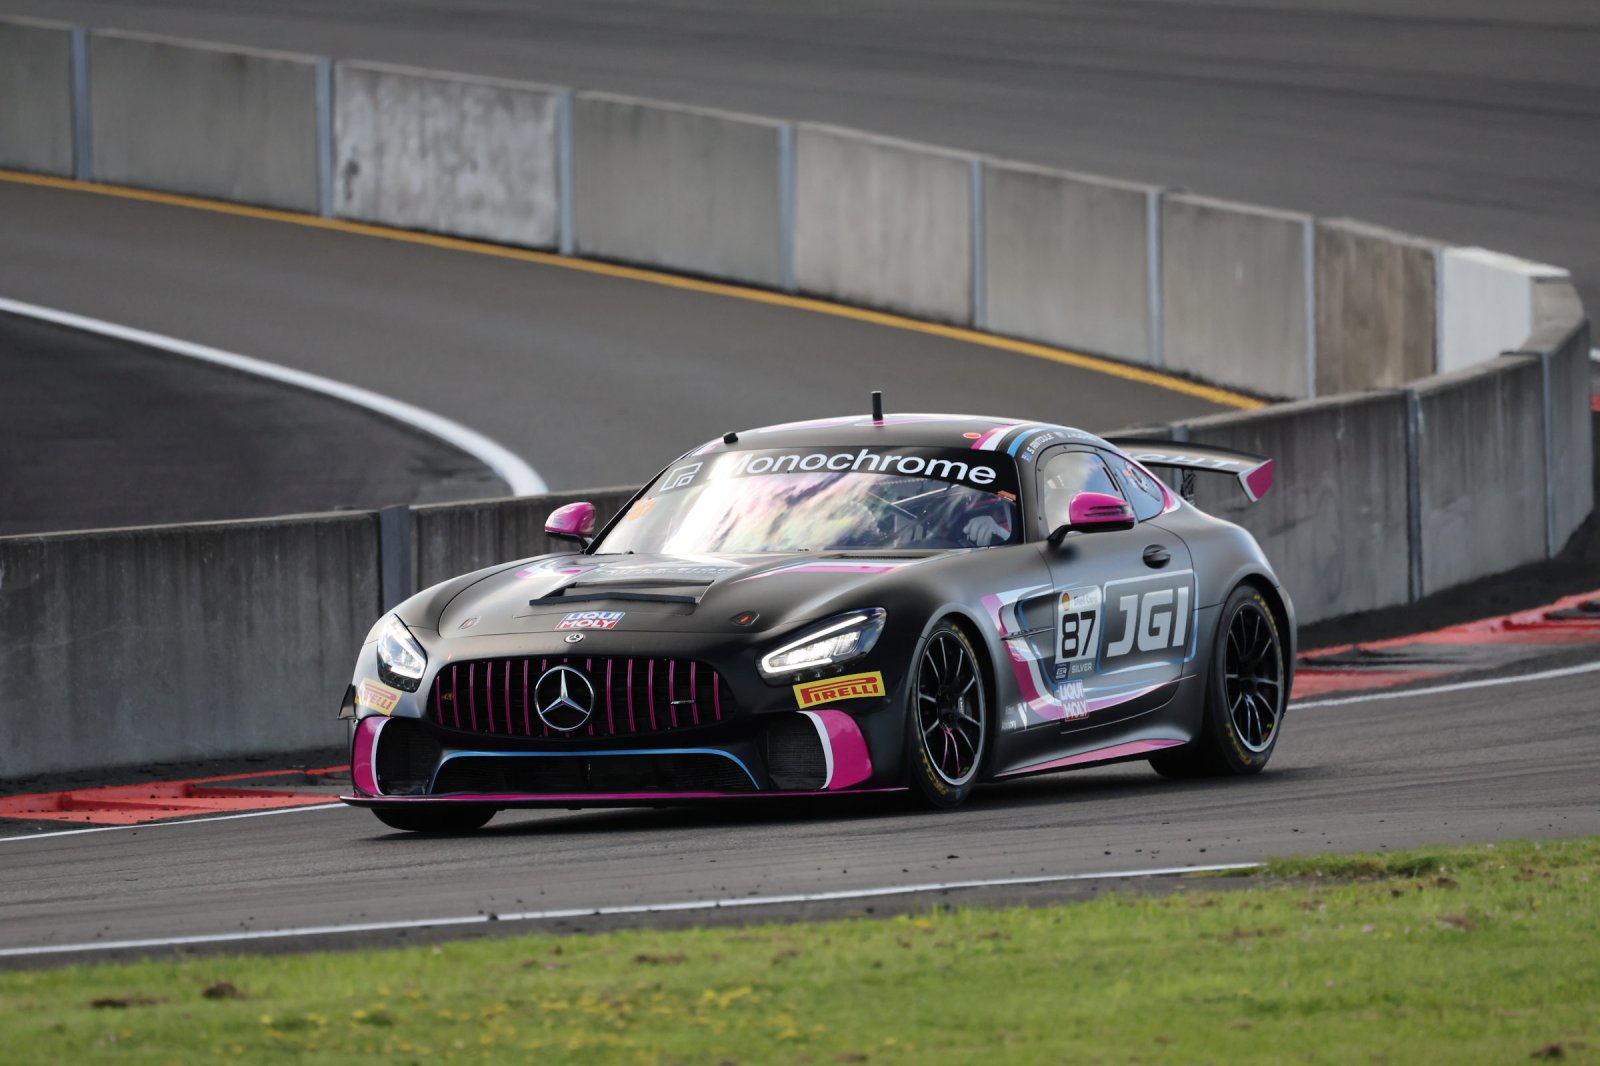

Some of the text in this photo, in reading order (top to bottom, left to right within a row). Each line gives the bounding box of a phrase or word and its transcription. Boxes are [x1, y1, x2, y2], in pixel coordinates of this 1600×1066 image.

[558, 619, 617, 629] MOLY
[564, 611, 623, 620] LIQUI
[1107, 586, 1189, 658] JGI
[1061, 609, 1097, 659] 87
[1071, 662, 1093, 673] SILVER
[360, 682, 398, 710] PELLI
[800, 676, 879, 704] PIRELLI
[1059, 681, 1084, 700] LIQUI
[1063, 700, 1089, 719] MOLY
